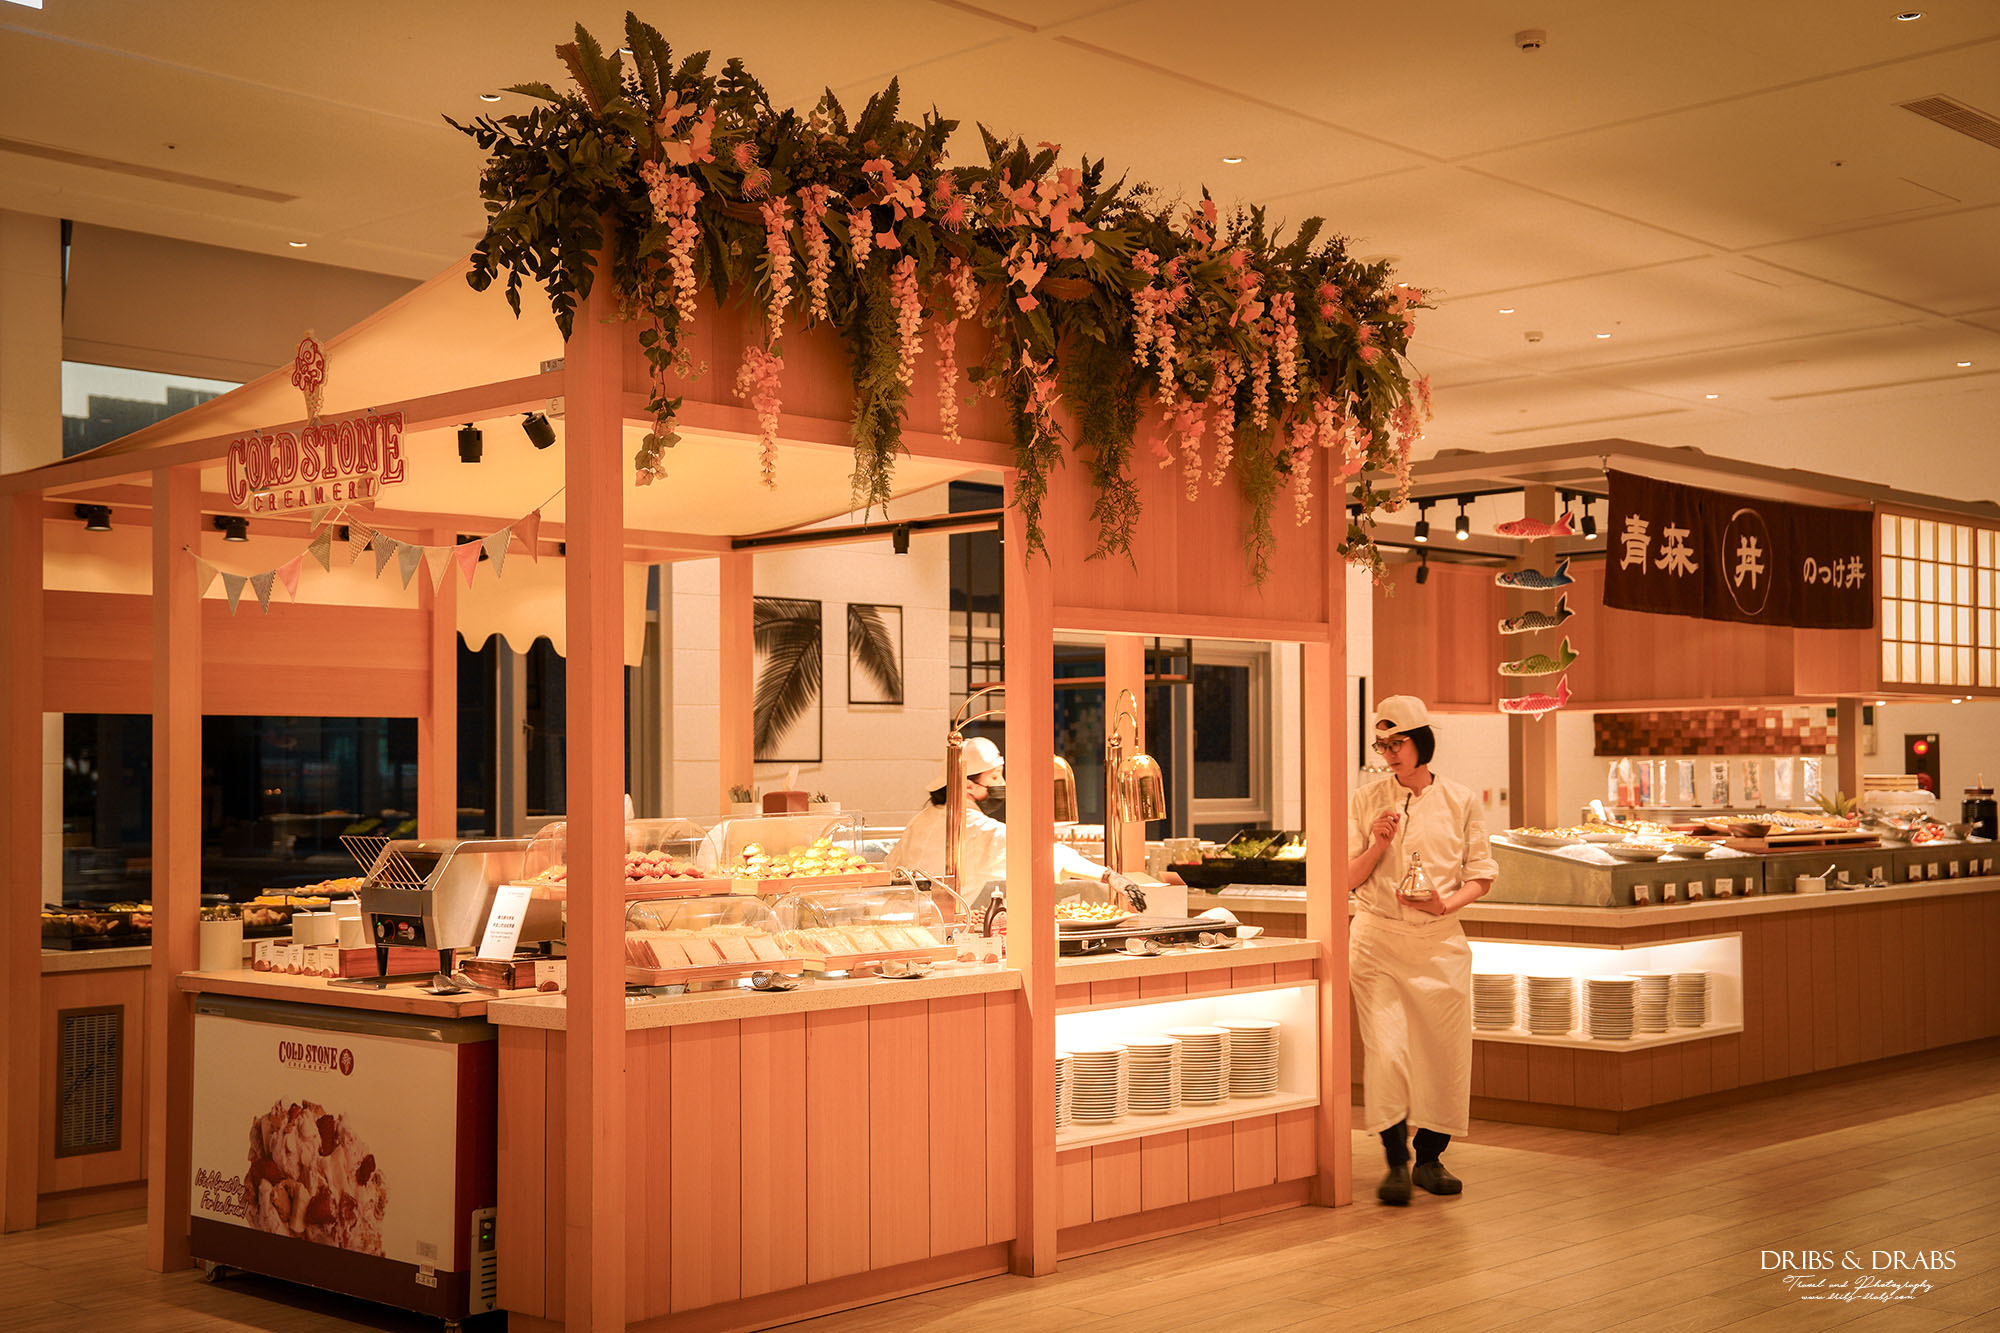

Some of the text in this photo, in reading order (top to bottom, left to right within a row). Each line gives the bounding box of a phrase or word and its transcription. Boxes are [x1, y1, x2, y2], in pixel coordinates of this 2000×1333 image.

[227, 412, 404, 505] COLD STONE
[253, 477, 374, 512] CREAMERY
[1619, 513, 1867, 590] 青森 丼 のっけ丼
[279, 1041, 338, 1070] COLD STONE
